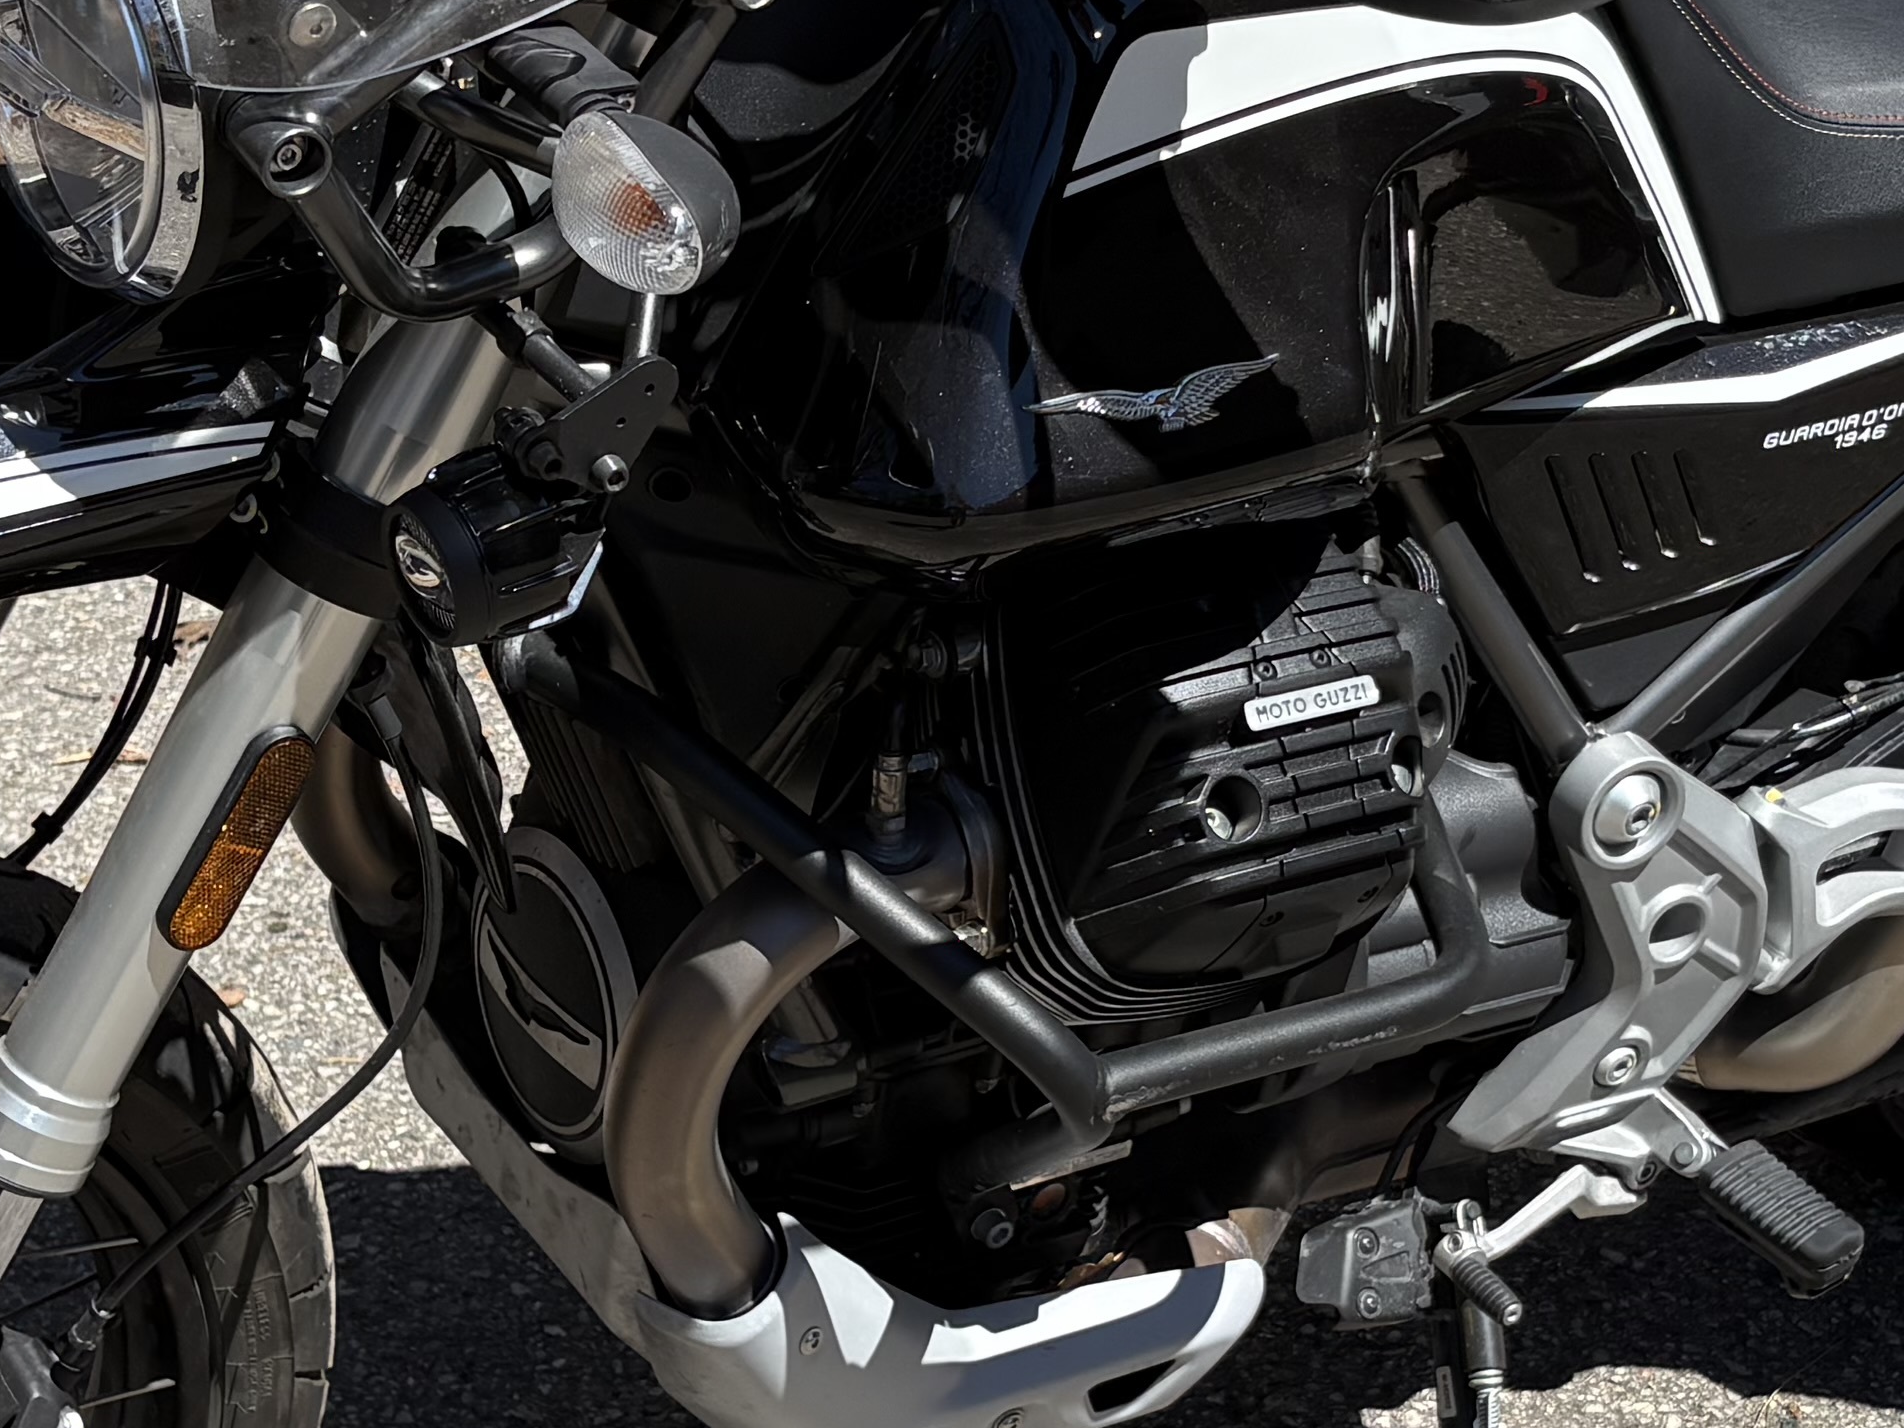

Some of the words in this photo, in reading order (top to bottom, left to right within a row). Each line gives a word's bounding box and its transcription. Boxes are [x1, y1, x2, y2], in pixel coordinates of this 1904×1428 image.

[1763, 412, 1860, 450] GUARDIA
[1834, 422, 1889, 450] 1946
[1255, 697, 1308, 724] MOTO
[1313, 682, 1369, 710] GUZZI
